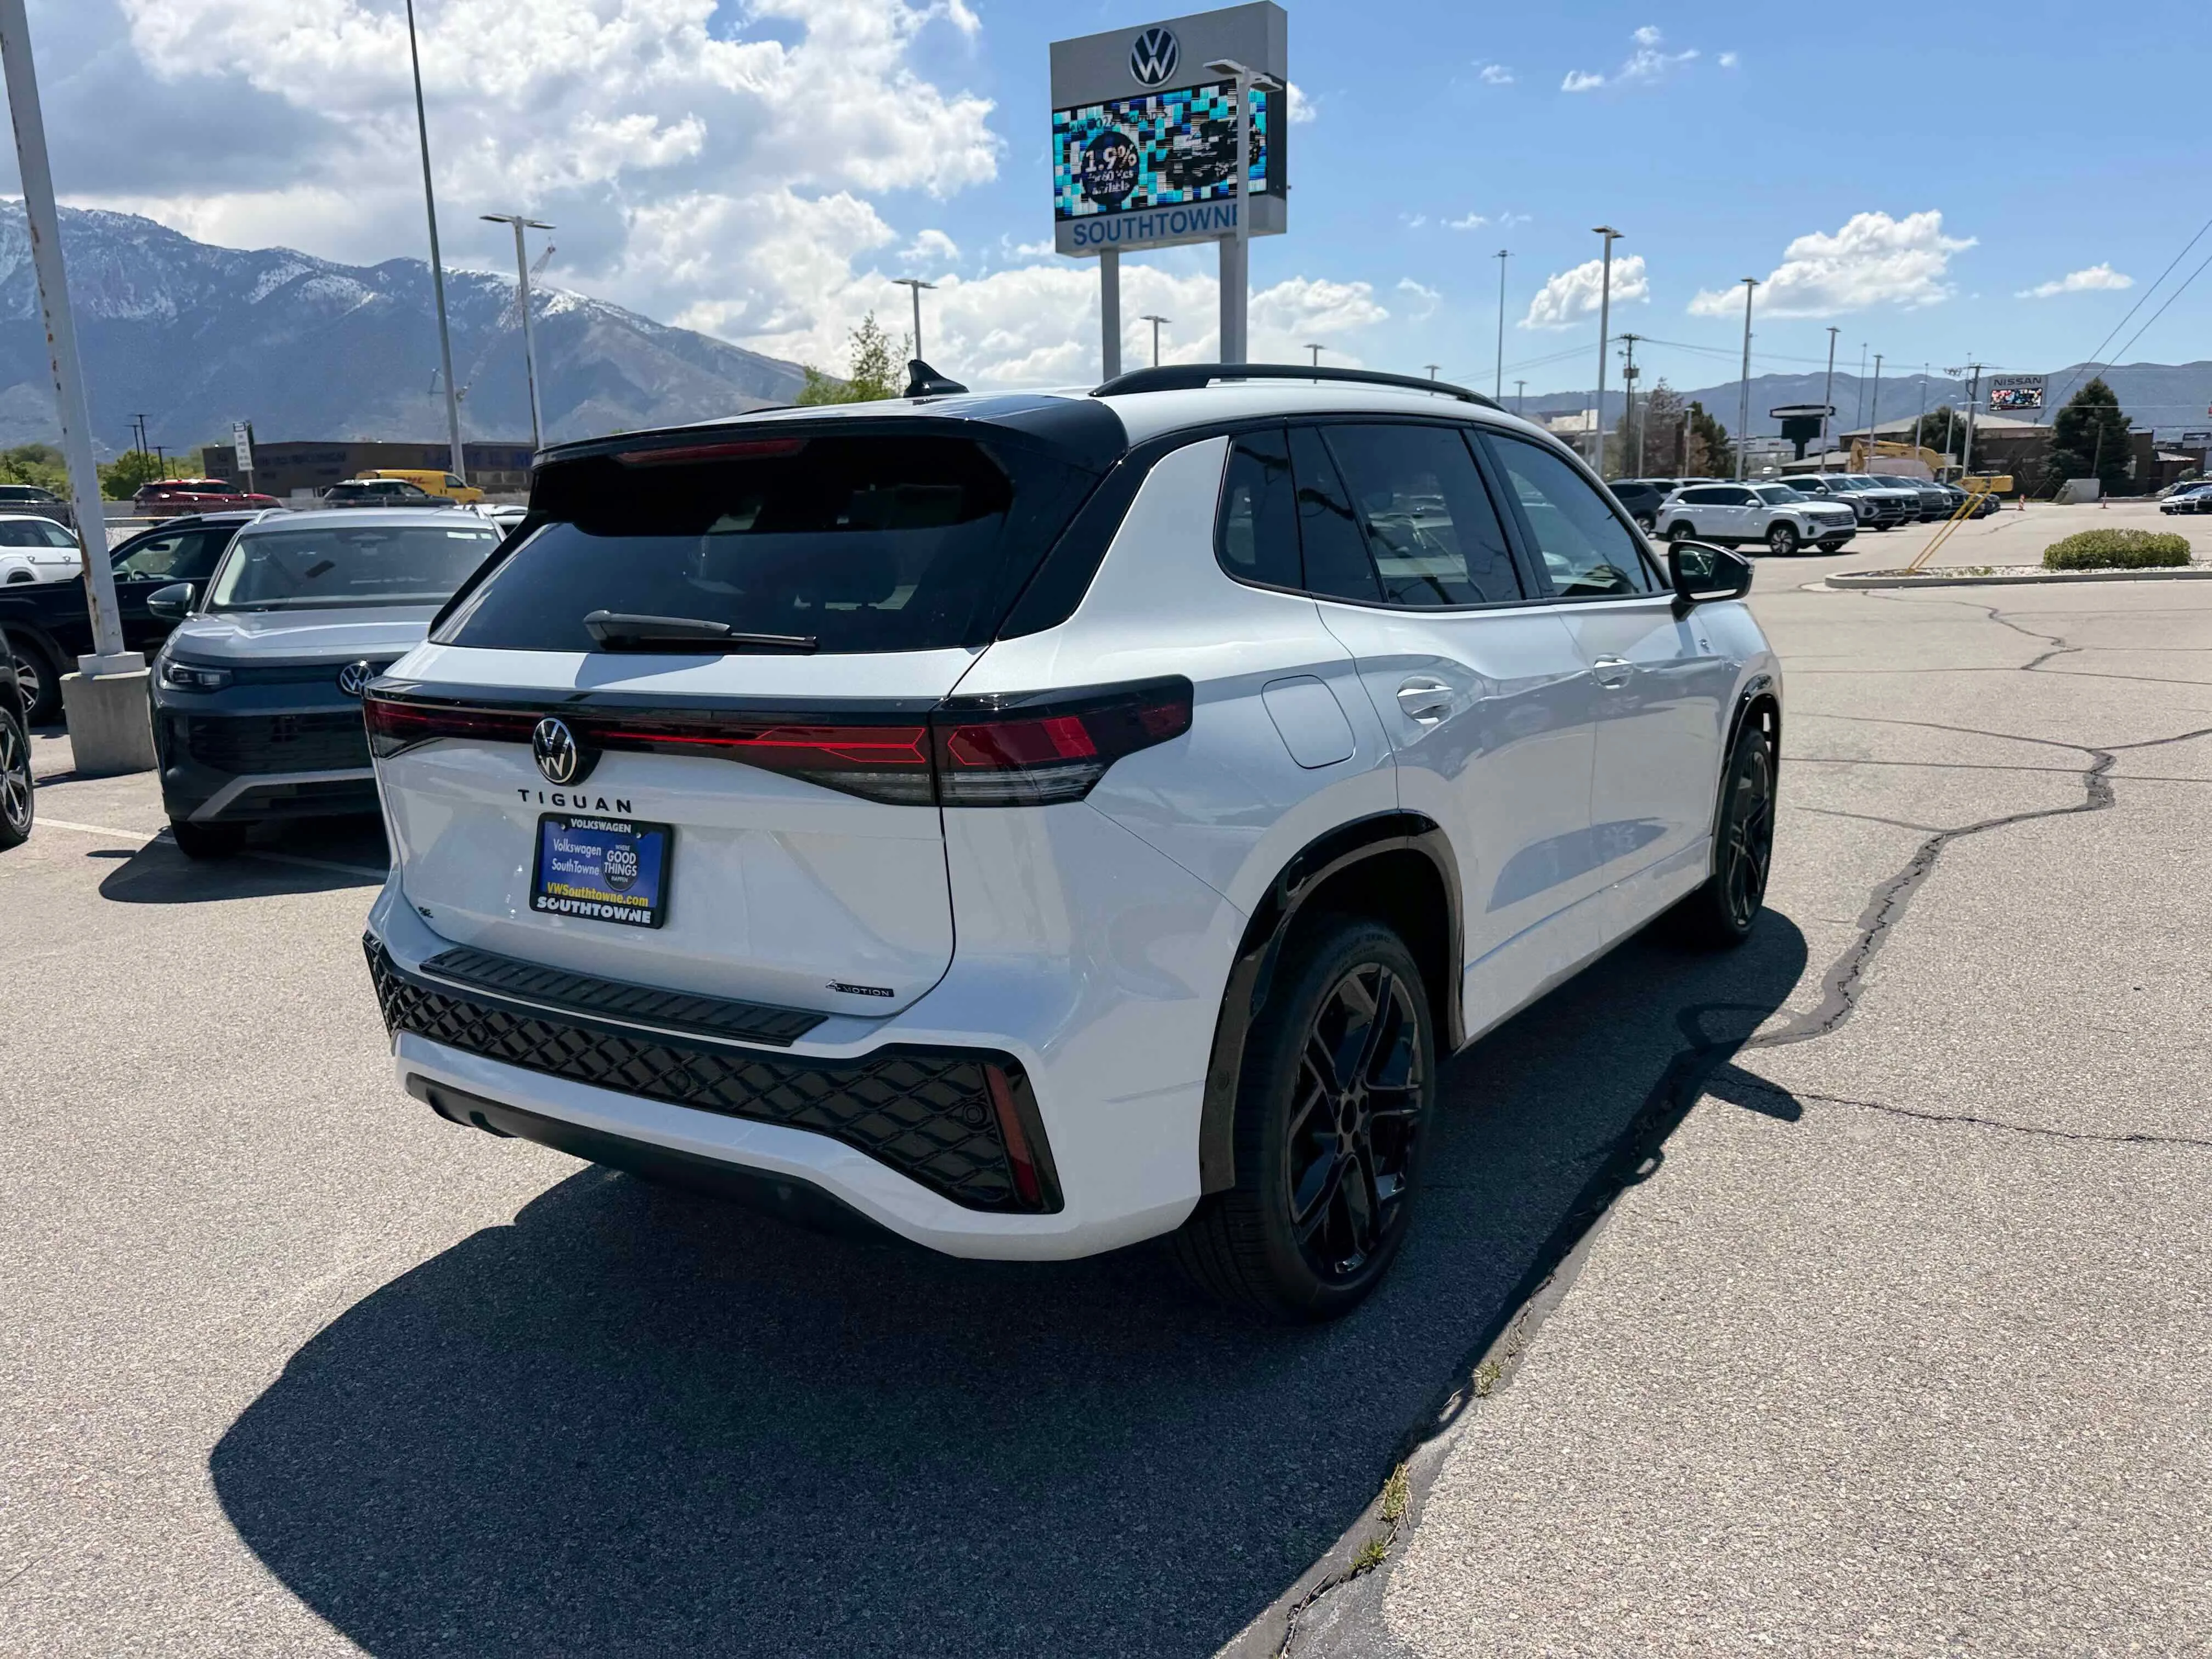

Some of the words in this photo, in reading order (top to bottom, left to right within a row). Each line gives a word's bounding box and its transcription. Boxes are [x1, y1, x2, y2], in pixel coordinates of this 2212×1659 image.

[1129, 27, 1180, 88] VW
[1085, 144, 1137, 172] 1.9%
[1994, 377, 2041, 386] NISSAN
[517, 789, 632, 813] TIGUAN
[571, 818, 631, 833] VOLKSWAGEN
[553, 838, 602, 859] Volkswagen
[607, 850, 636, 865] GOOD
[551, 858, 600, 876] SouthTowne
[603, 862, 637, 877] THINGS
[547, 882, 648, 907] VWSouthtowne.com
[537, 896, 652, 924] SOUTHTOWNE
